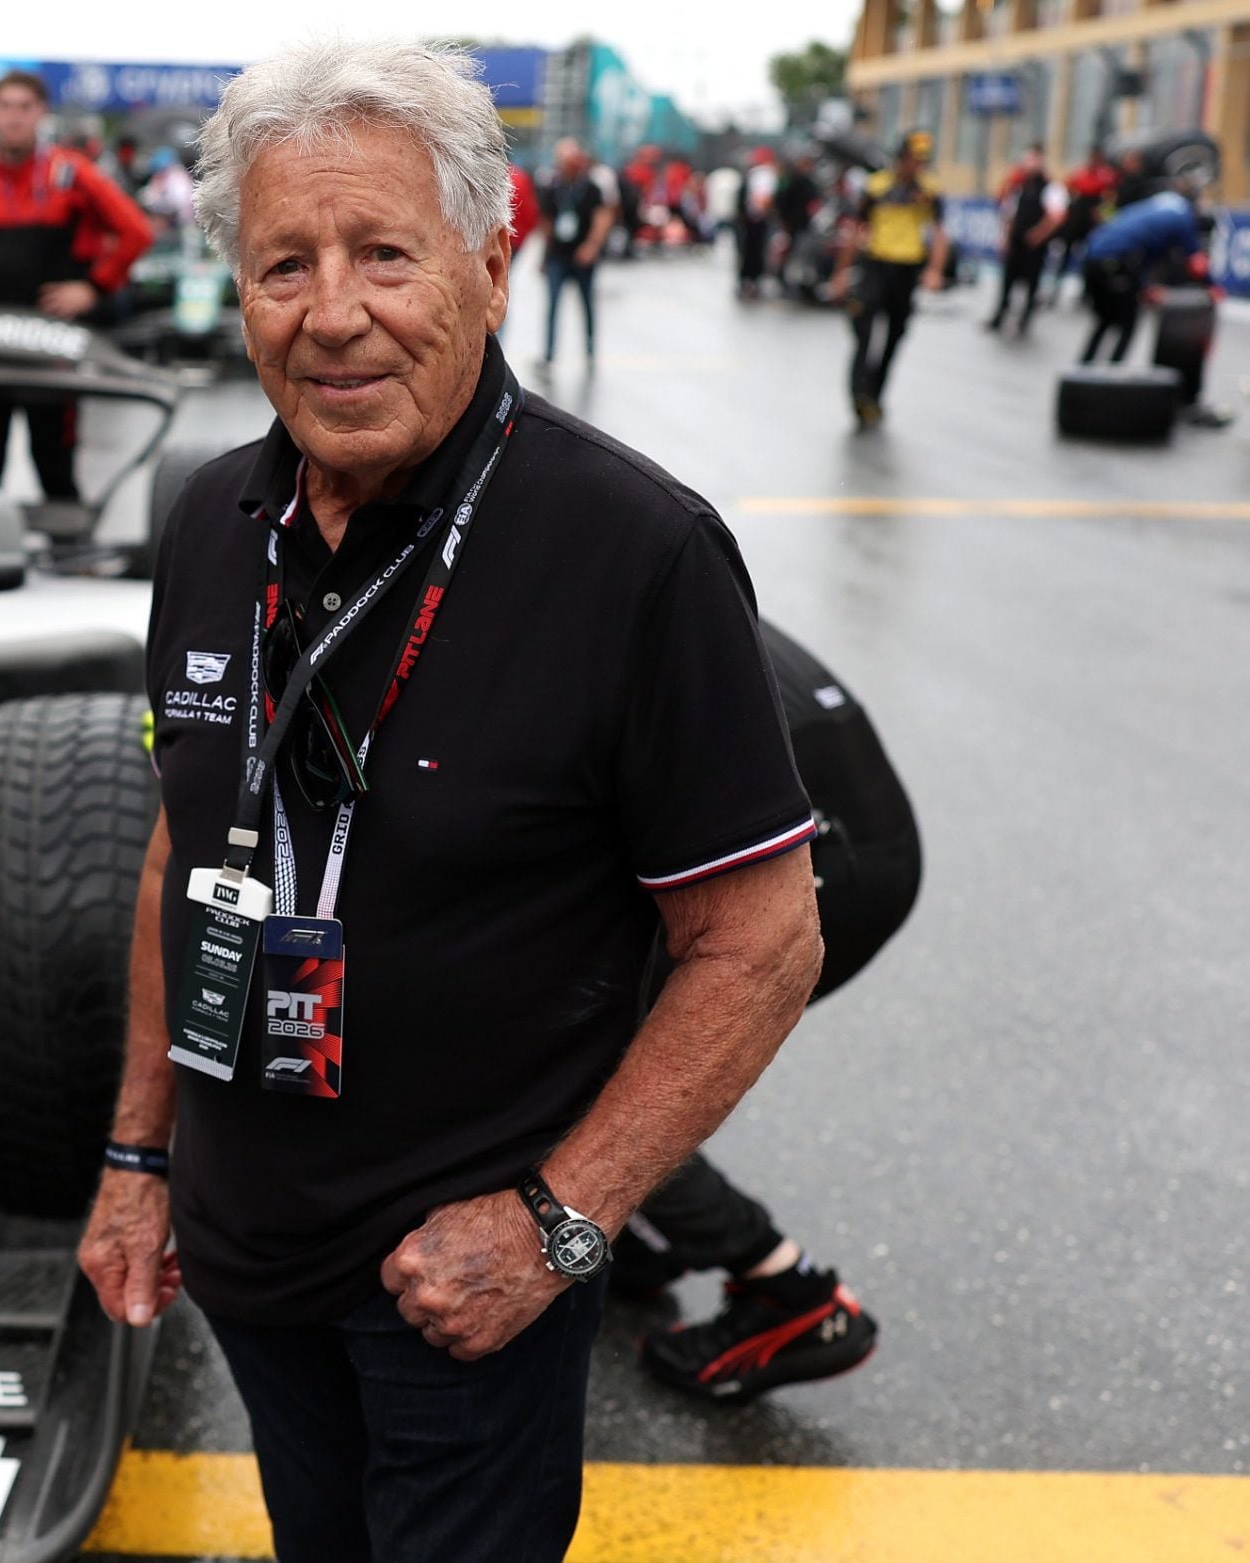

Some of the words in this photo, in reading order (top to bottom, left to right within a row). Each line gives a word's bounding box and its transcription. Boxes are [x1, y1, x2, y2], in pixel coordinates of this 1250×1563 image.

[324, 578, 385, 645] PADDOCK
[383, 544, 415, 578] CLUB
[250, 624, 261, 703] PADDOCK
[165, 690, 238, 711] CADILLAC
[204, 711, 233, 725] TEAM
[248, 705, 258, 748] CLUB
[332, 813, 350, 855] GRID
[215, 886, 237, 902] TWG
[200, 940, 243, 962] SUNDAY
[191, 999, 230, 1018] CADILLAC
[266, 989, 323, 1021] PIT
[268, 1020, 325, 1038] 2026
